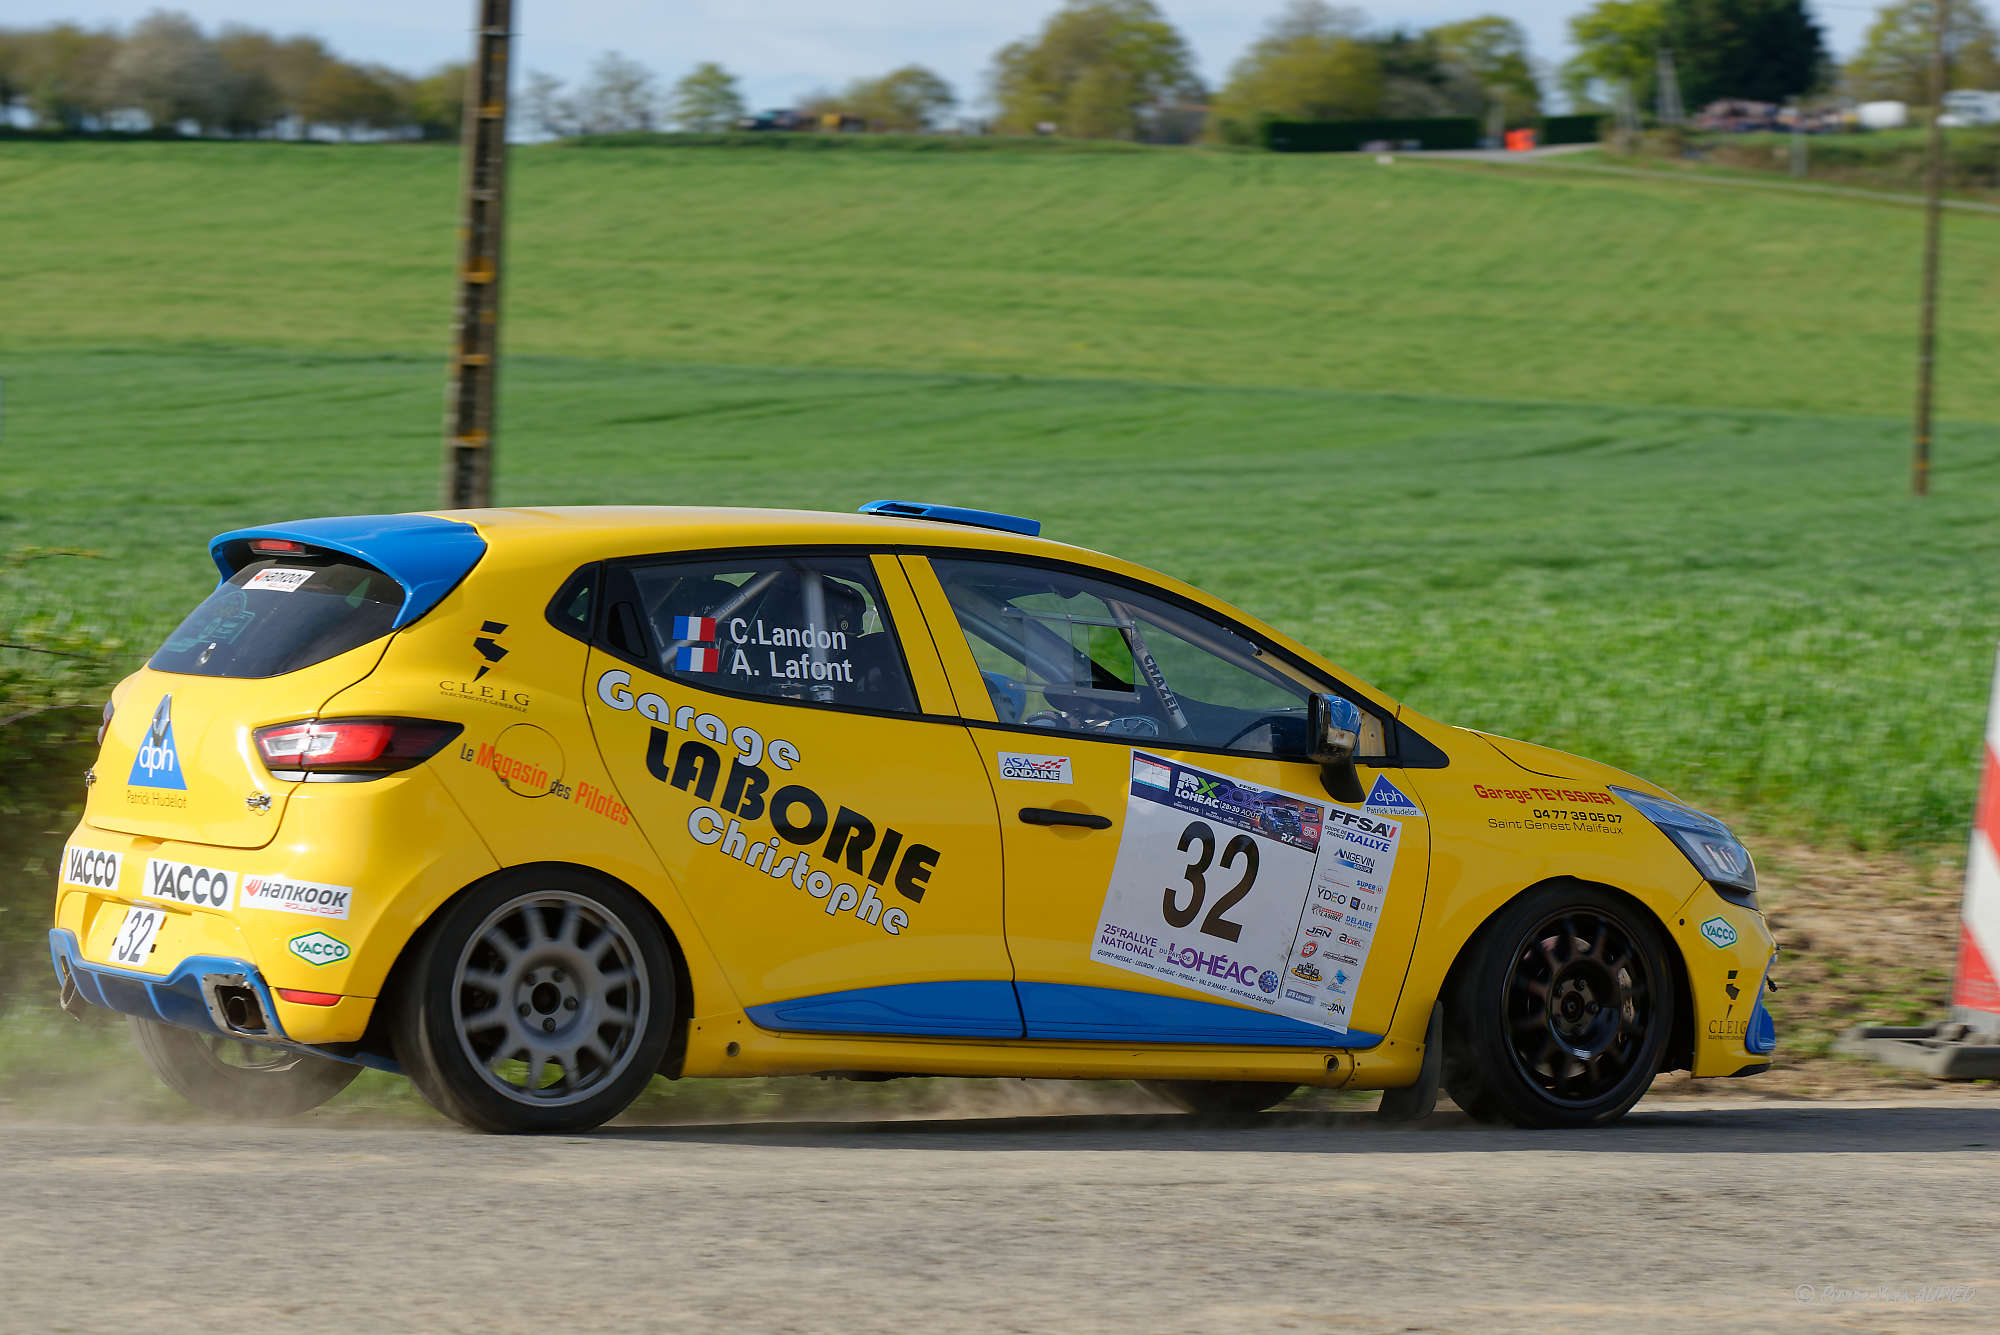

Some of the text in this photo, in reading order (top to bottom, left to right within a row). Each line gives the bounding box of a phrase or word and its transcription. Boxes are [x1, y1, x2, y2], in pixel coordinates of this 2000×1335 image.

[730, 617, 847, 650] C.Landon
[731, 649, 854, 682] A. Lafont
[439, 680, 531, 706] CLEIG
[596, 668, 801, 771] Garage
[139, 737, 174, 778] dph
[1004, 757, 1033, 771] ASA
[460, 742, 631, 826] Le Magasin des Pilotes
[1003, 766, 1060, 780] ONDAINE
[1174, 787, 1220, 809] LOHEAC
[1374, 788, 1404, 805] dph
[1473, 784, 1616, 805] Garage TEYSSIER
[645, 726, 941, 904] LABORIE
[1328, 808, 1388, 838] FFSA
[1488, 818, 1623, 835] Saint Genest Malifaux
[1533, 809, 1622, 823] 04 77 39 05 07
[1344, 831, 1390, 853] RALLYE
[70, 848, 117, 888] YACCO
[687, 806, 909, 936] Christophe
[1162, 820, 1260, 943] 32
[152, 861, 228, 907] YACCO
[118, 911, 155, 963] 32
[1101, 934, 1155, 959] NATIONAL
[1119, 928, 1158, 948] RALLYE
[1704, 924, 1735, 941] YACCO
[294, 940, 345, 957] YACCO
[1167, 943, 1258, 987] LOHÉAC
